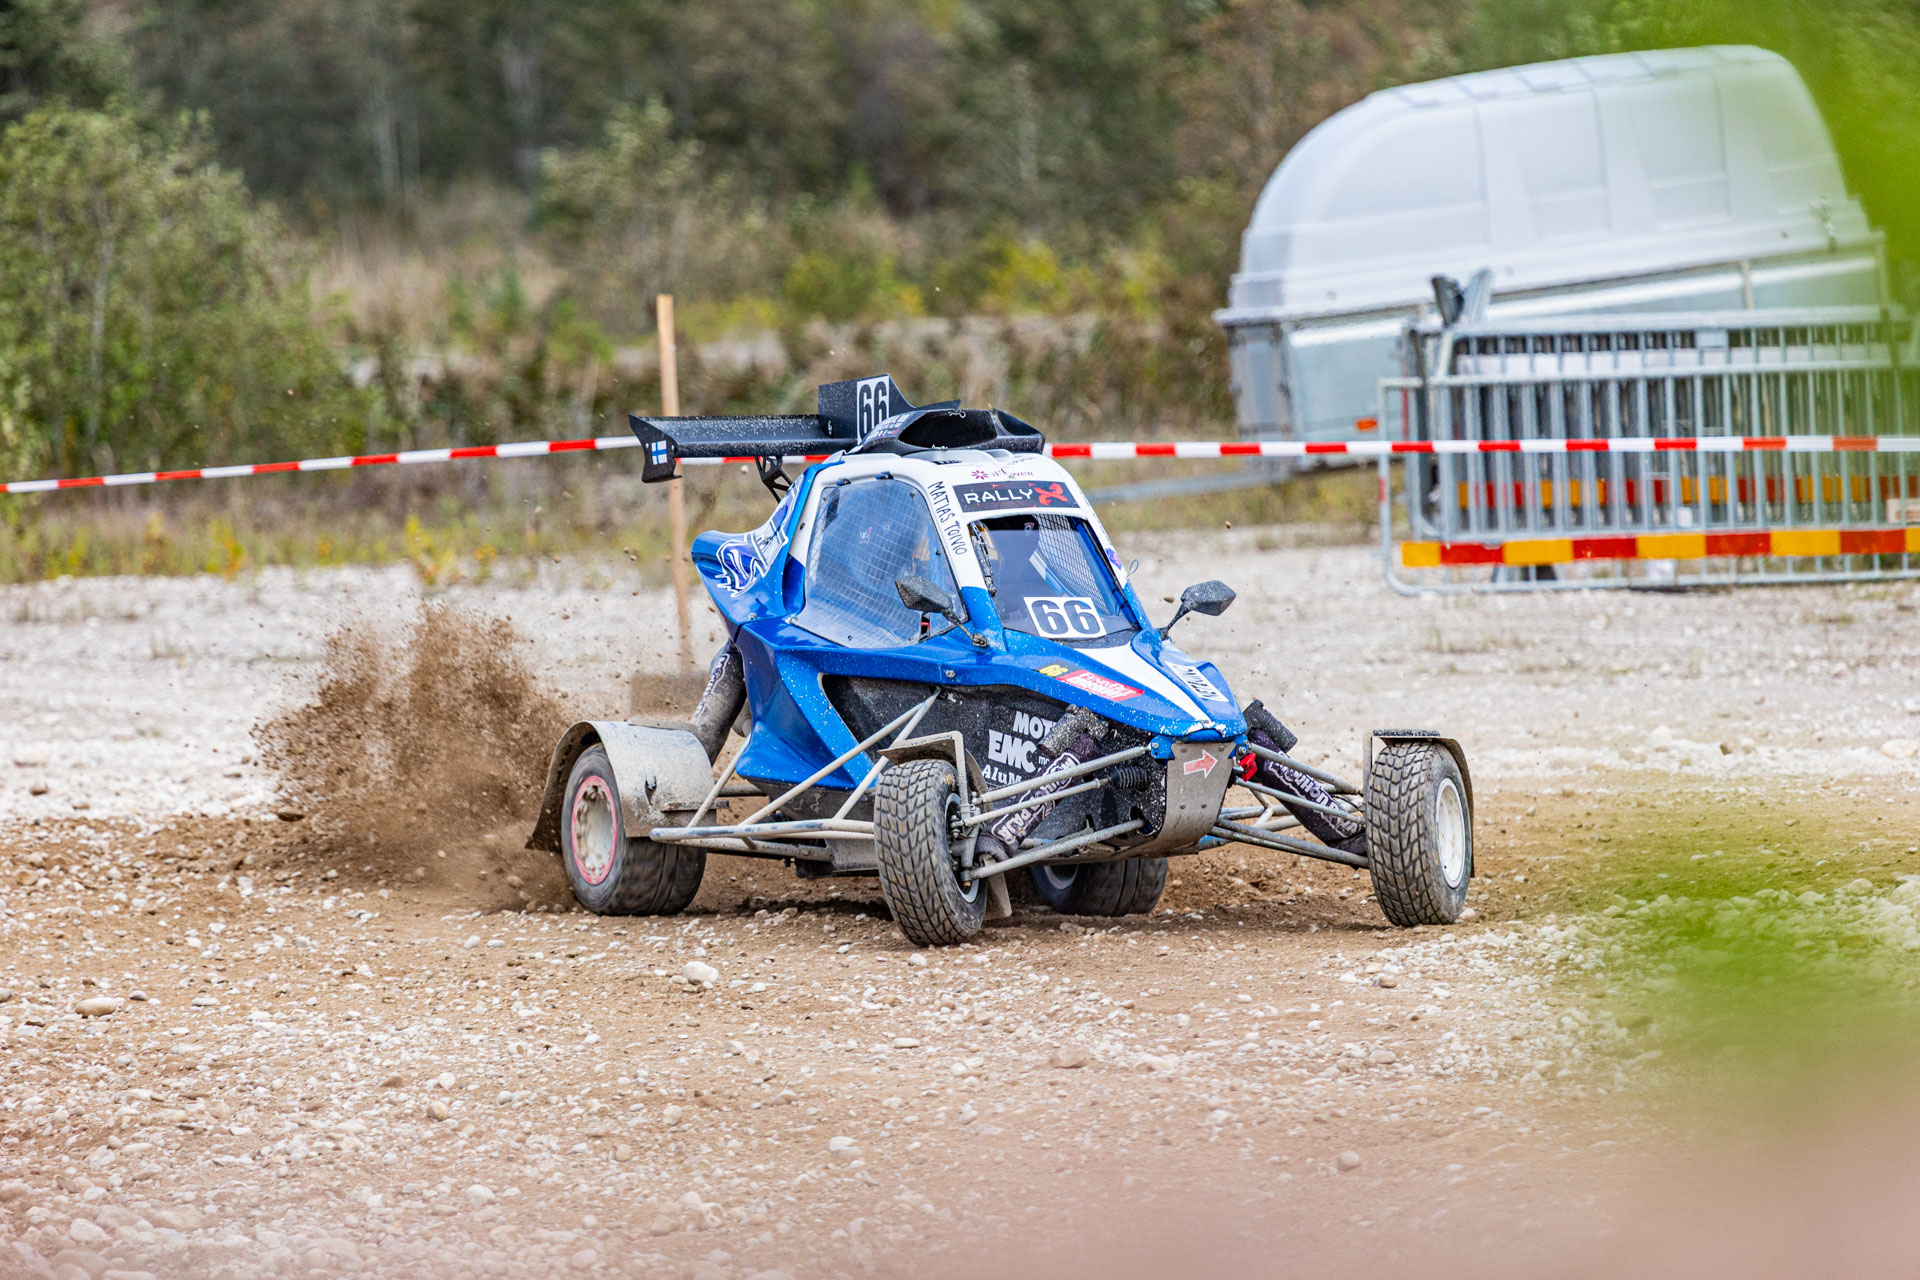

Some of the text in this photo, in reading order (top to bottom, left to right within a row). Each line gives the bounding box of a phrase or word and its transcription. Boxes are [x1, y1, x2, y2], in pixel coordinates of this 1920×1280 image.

[859, 381, 887, 440] 66
[928, 480, 956, 523] MATIAS
[1031, 600, 1101, 635] 66
[1013, 710, 1055, 739] MOT
[988, 729, 1037, 773] EMC
